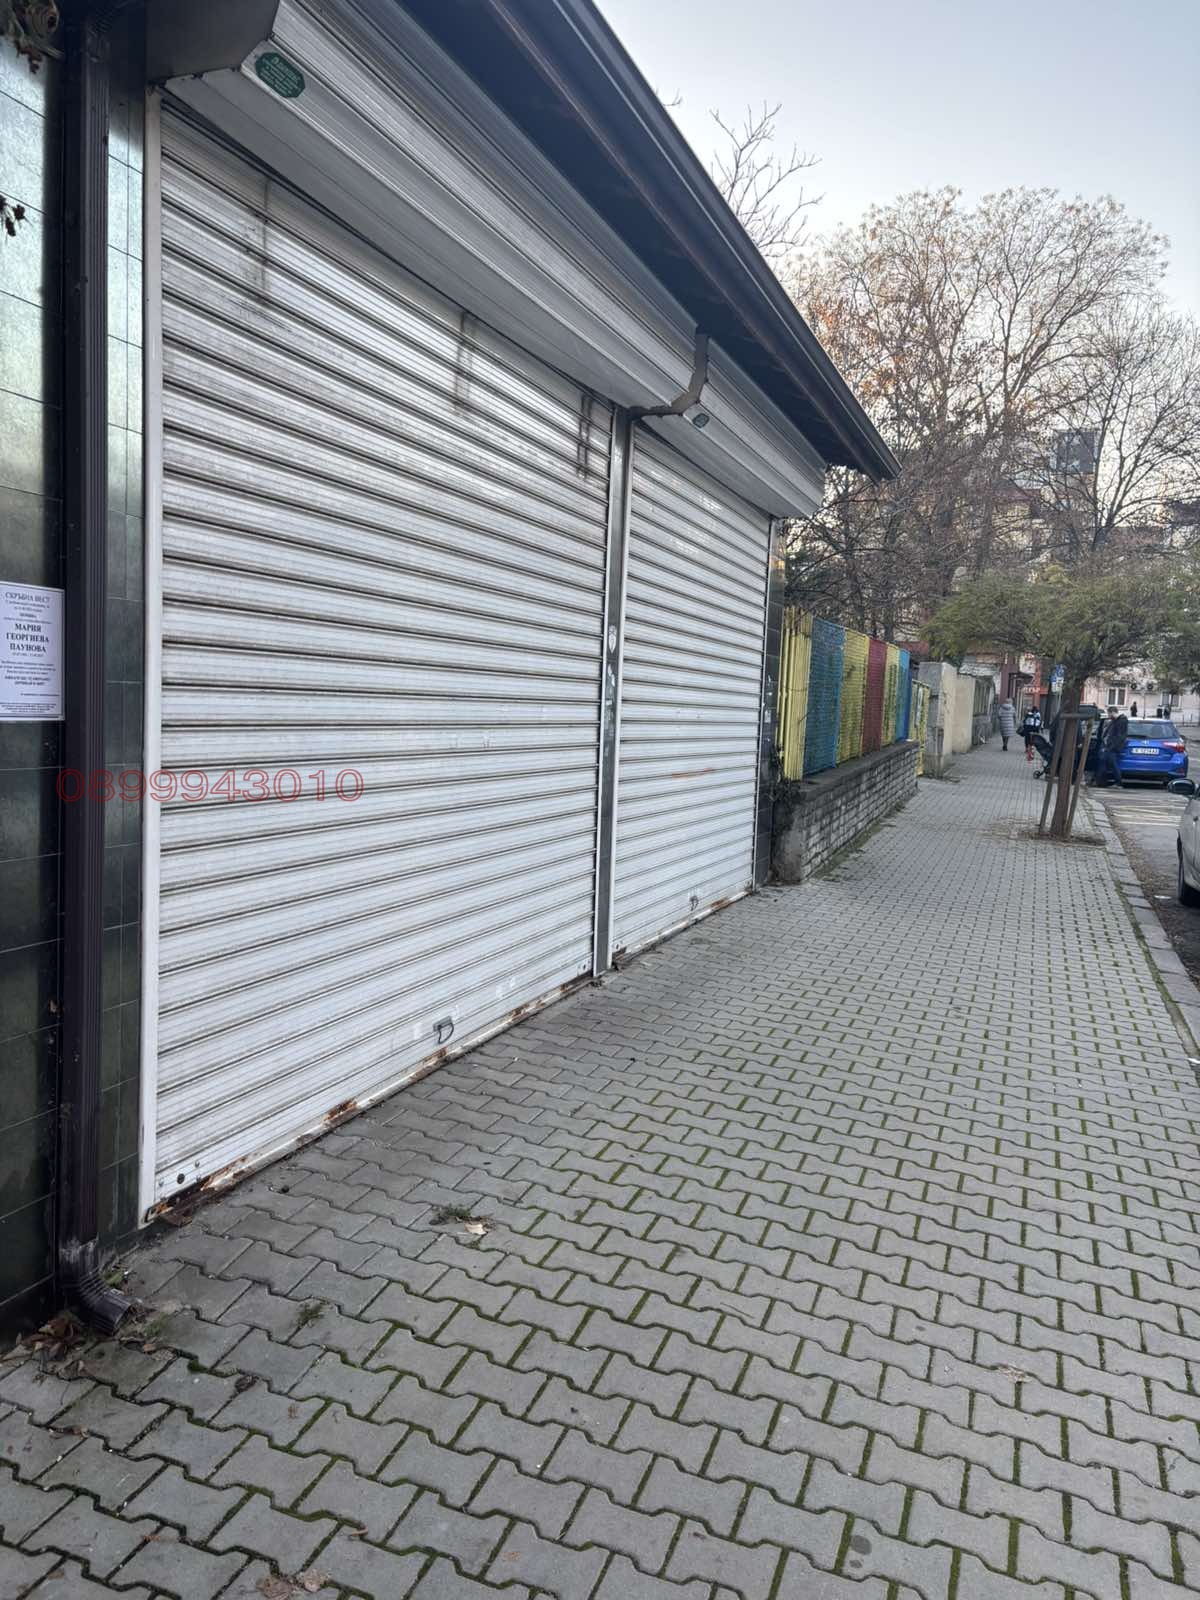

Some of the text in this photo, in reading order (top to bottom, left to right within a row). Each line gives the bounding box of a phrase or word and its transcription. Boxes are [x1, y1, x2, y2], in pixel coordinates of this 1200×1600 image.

[15, 623, 42, 632] МАРИЯ
[6, 632, 49, 642] ГЕОРГИЕВА
[9, 642, 47, 653] ПАУНОВА
